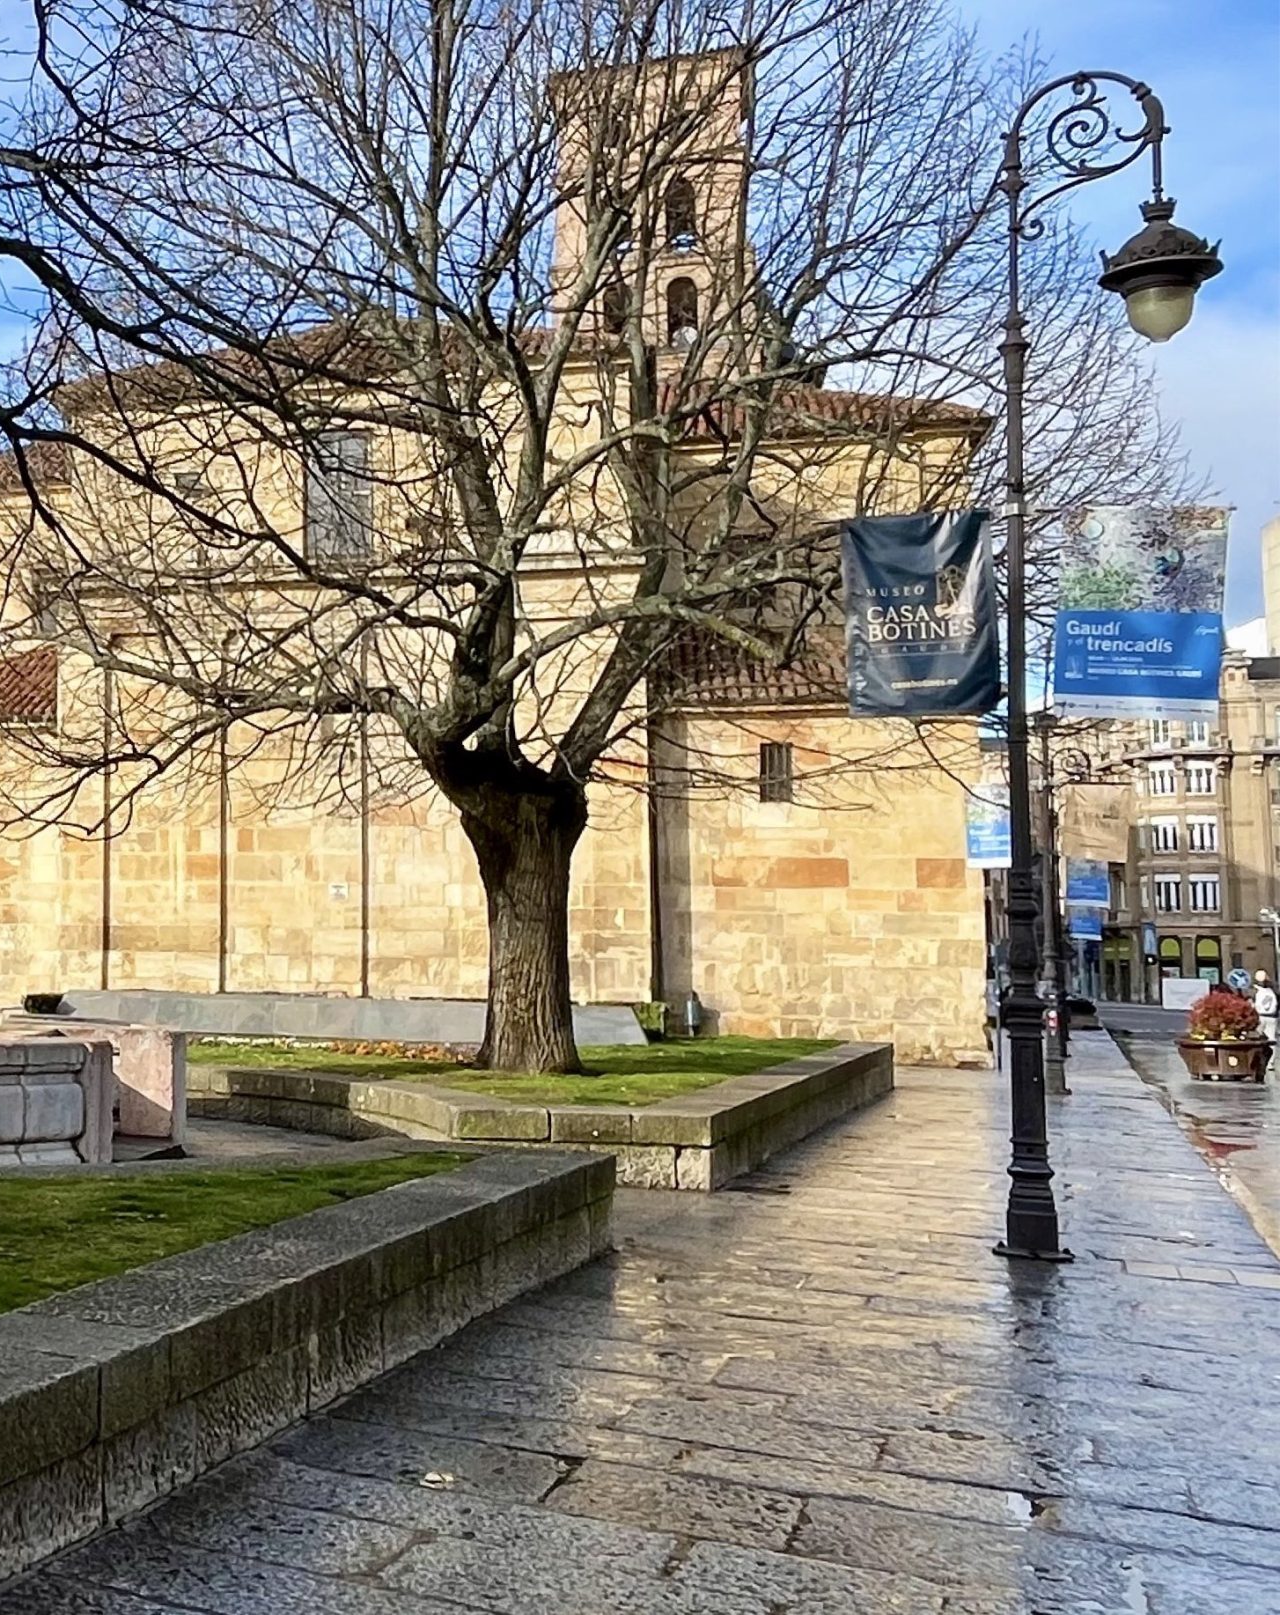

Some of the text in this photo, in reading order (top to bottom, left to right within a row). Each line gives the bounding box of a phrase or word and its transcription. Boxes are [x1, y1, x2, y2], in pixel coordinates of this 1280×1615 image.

[866, 584, 925, 598] MUSEO
[866, 604, 930, 624] CASA
[867, 617, 976, 643] BOTINES
[1066, 619, 1122, 636] Gaudí
[1086, 636, 1174, 653] trencadís
